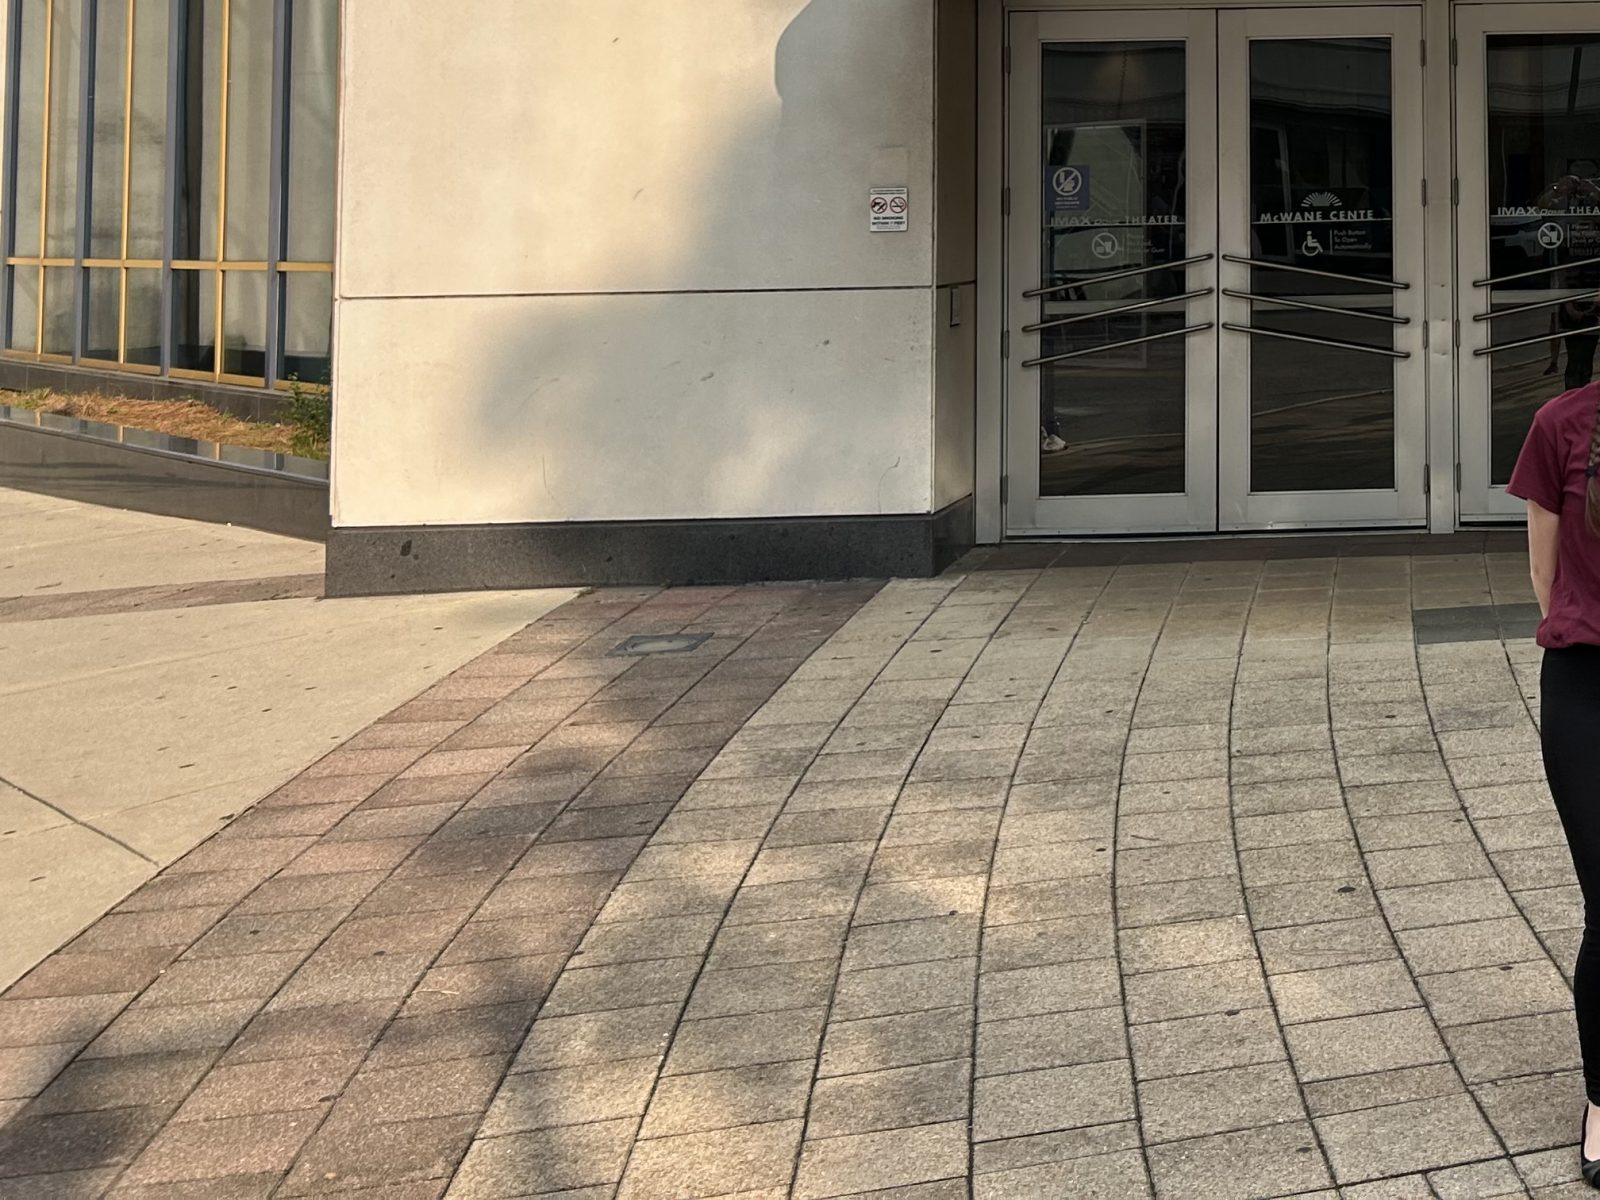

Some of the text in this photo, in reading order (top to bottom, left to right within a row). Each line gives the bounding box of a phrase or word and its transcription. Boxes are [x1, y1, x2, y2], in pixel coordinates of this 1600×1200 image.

[1498, 206, 1537, 215] IMAX
[1125, 215, 1178, 225] THEATER
[1260, 211, 1323, 222] McWANE
